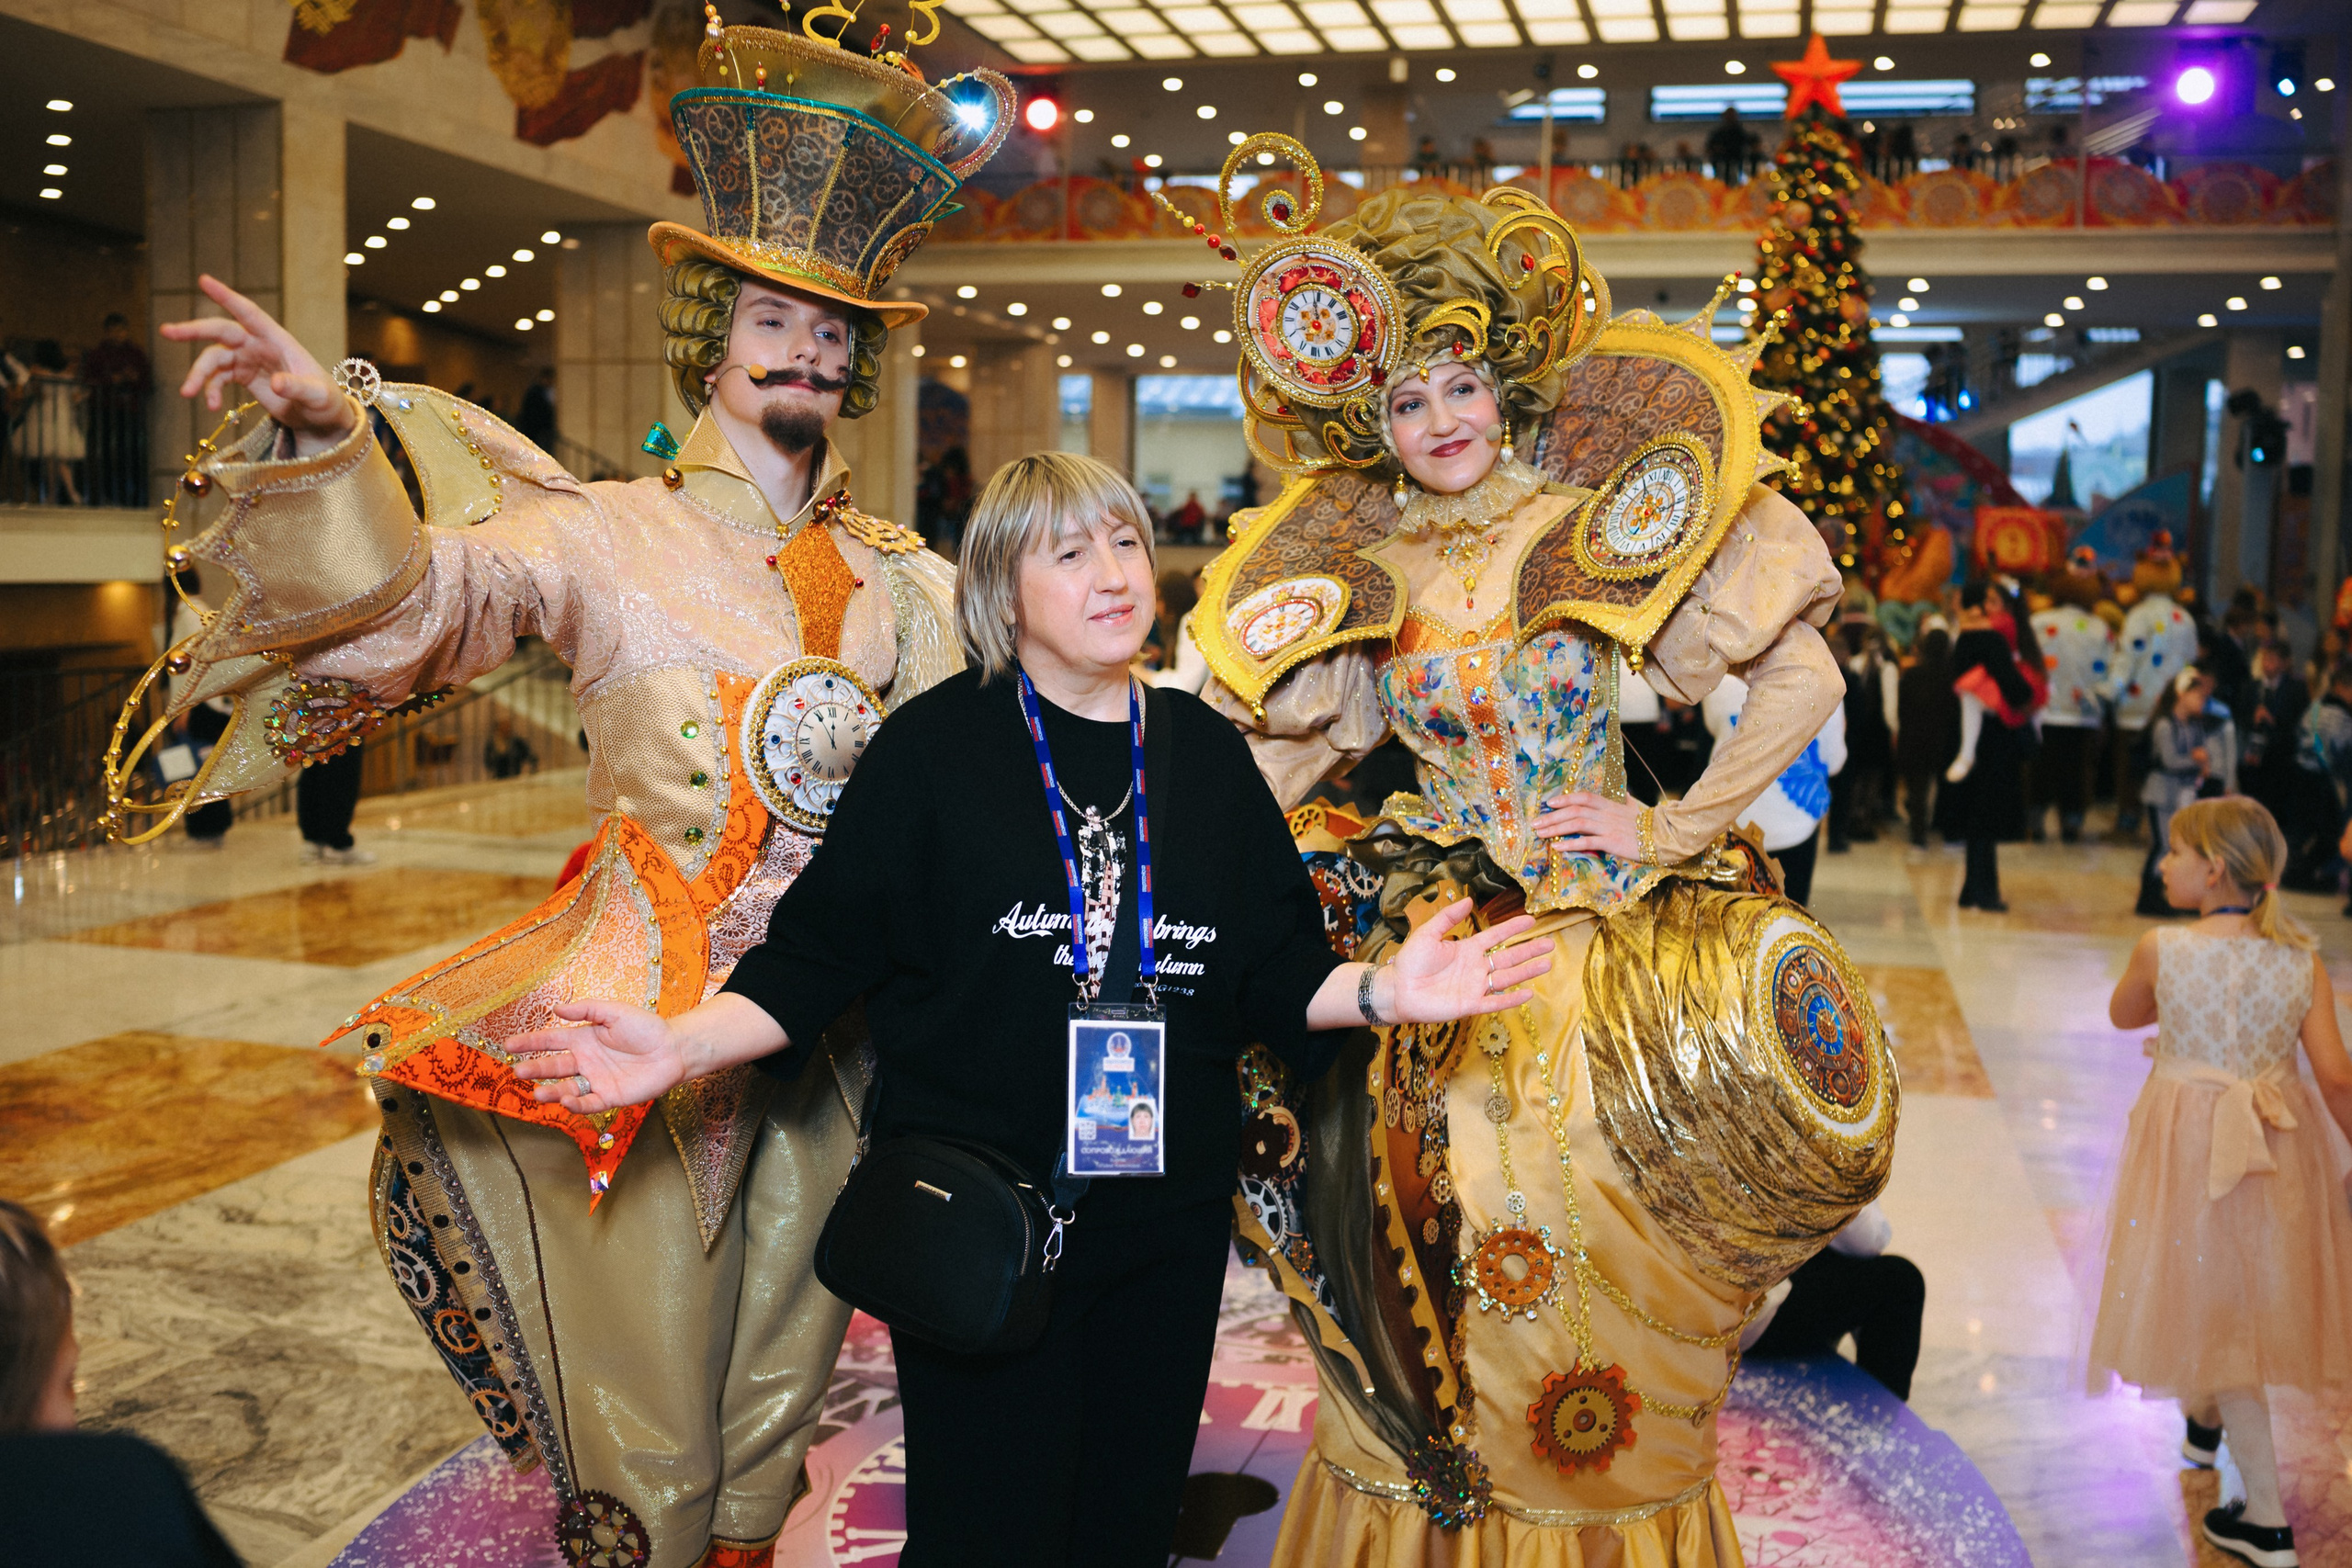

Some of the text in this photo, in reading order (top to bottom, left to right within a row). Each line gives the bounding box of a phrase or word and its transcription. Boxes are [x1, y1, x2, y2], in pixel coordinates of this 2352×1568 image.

[1647, 471, 1657, 483] XI
[1632, 484, 1640, 494] X
[1616, 500, 1628, 511] IX
[1670, 514, 1680, 526] III
[1656, 533, 1666, 545] IV
[1638, 542, 1646, 551] V
[827, 706, 837, 718] XII
[803, 721, 814, 731] X
[852, 724, 861, 733] II
[799, 737, 810, 745] IX
[854, 740, 865, 749] III
[801, 749, 814, 764] VIII
[811, 761, 823, 774] VII
[828, 766, 835, 779] VI
[843, 764, 850, 776] V
[992, 901, 1073, 939] Autum
[1153, 914, 1216, 950] brings
[1138, 953, 1205, 976] utumn
